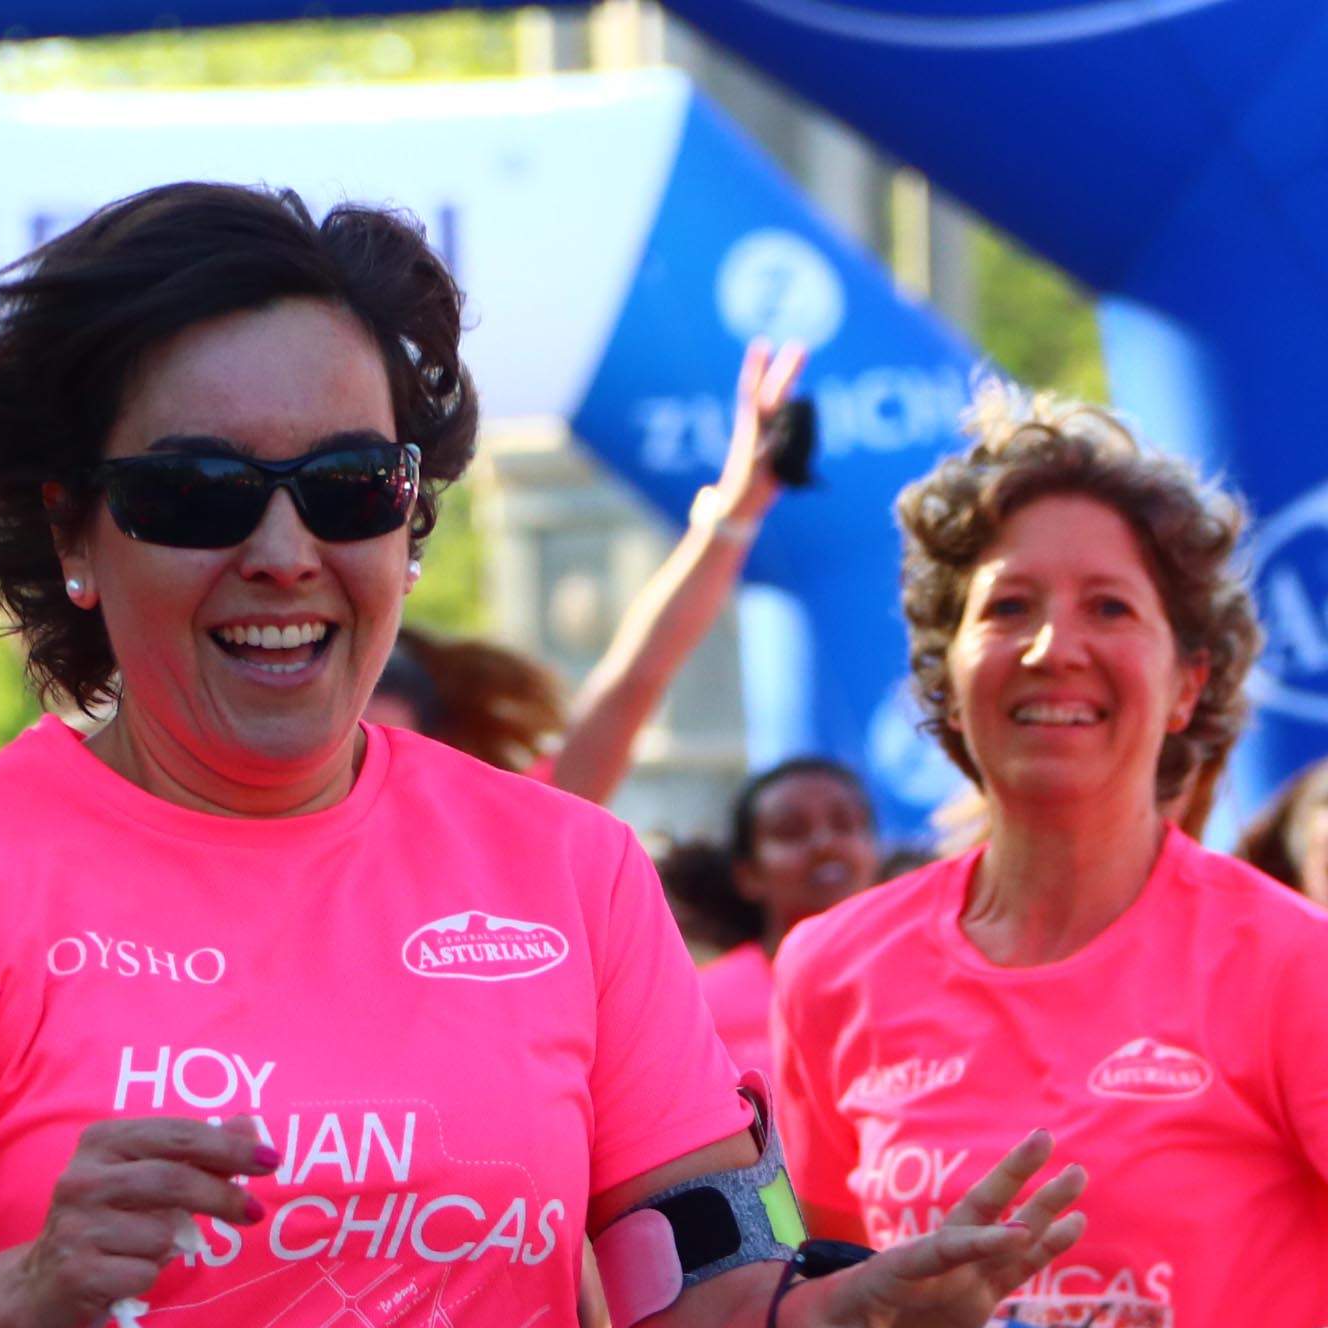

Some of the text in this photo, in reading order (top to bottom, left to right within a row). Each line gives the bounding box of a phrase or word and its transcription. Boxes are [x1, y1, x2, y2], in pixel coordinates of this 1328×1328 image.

[47, 931, 226, 984] OYSHO
[418, 940, 559, 970] ASTURIANA
[113, 1045, 276, 1110] HOY
[862, 1147, 969, 1201] HOY
[269, 1191, 565, 1266] CHICAS
